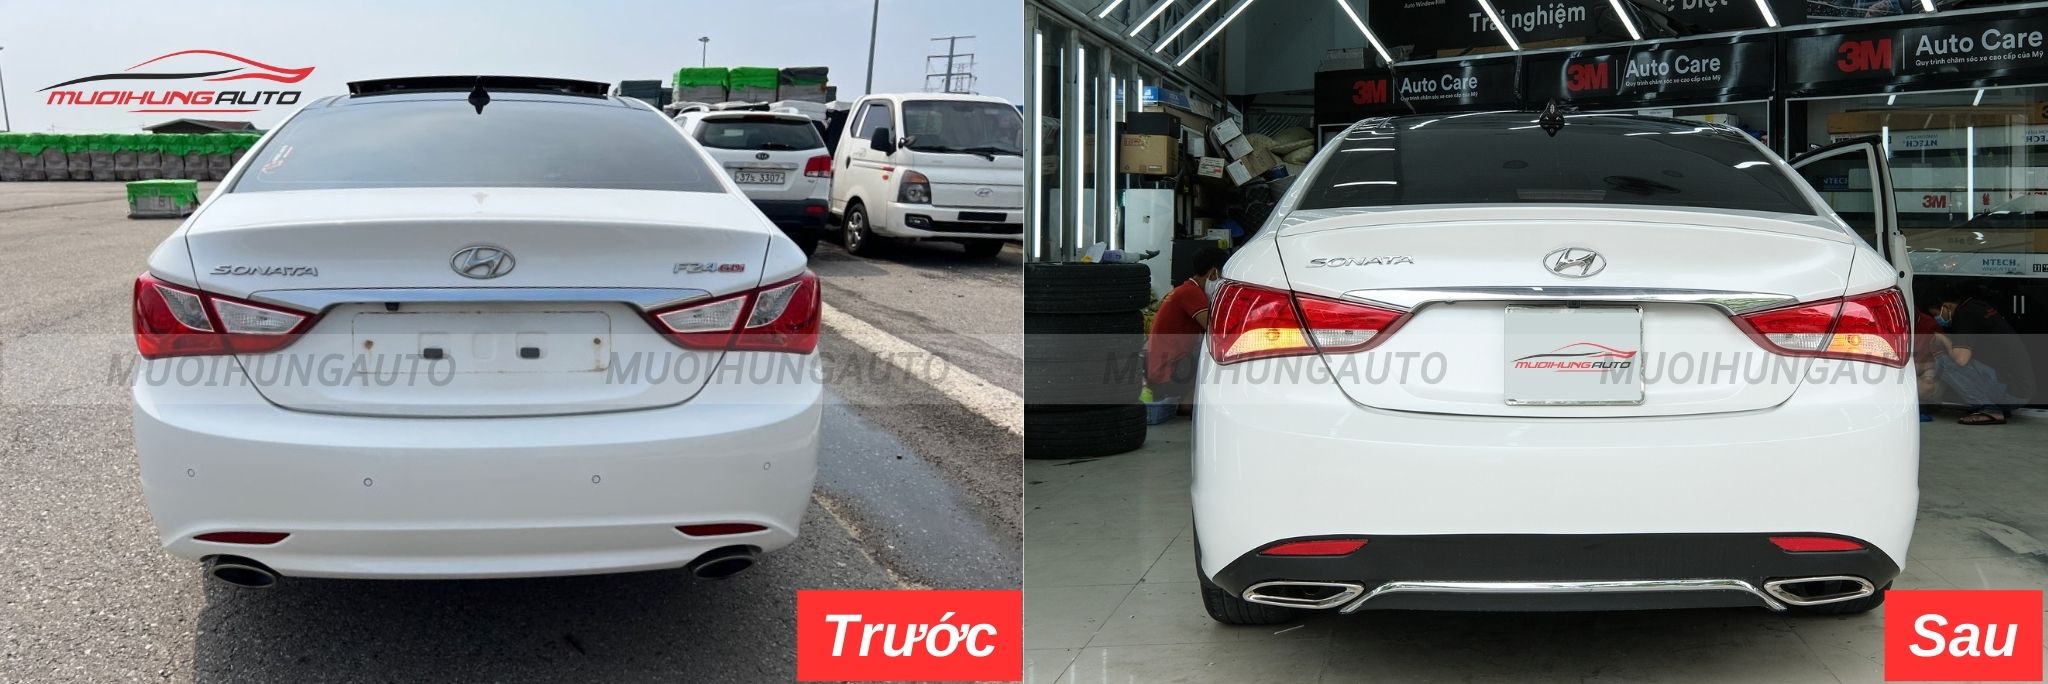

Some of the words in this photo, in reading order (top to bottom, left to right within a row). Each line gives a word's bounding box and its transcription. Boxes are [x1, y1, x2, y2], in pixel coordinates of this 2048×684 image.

[1511, 3, 1586, 31] nghiệm
[1837, 38, 1892, 73] 3M
[1915, 34, 1974, 56] Auto
[1981, 28, 2044, 51] Care
[2003, 52, 2016, 61] cấp
[1568, 62, 1608, 92] 3M
[1625, 59, 1669, 78] Auto
[1674, 55, 1720, 74] Care
[1352, 80, 1387, 104] 3M
[1400, 77, 1437, 93] Auto
[1441, 74, 1478, 91] Care
[1922, 195, 1946, 209] 3M
[1305, 255, 1415, 268] SONATA
[1982, 258, 2016, 266] NTECH
[209, 265, 319, 277] SONATA
